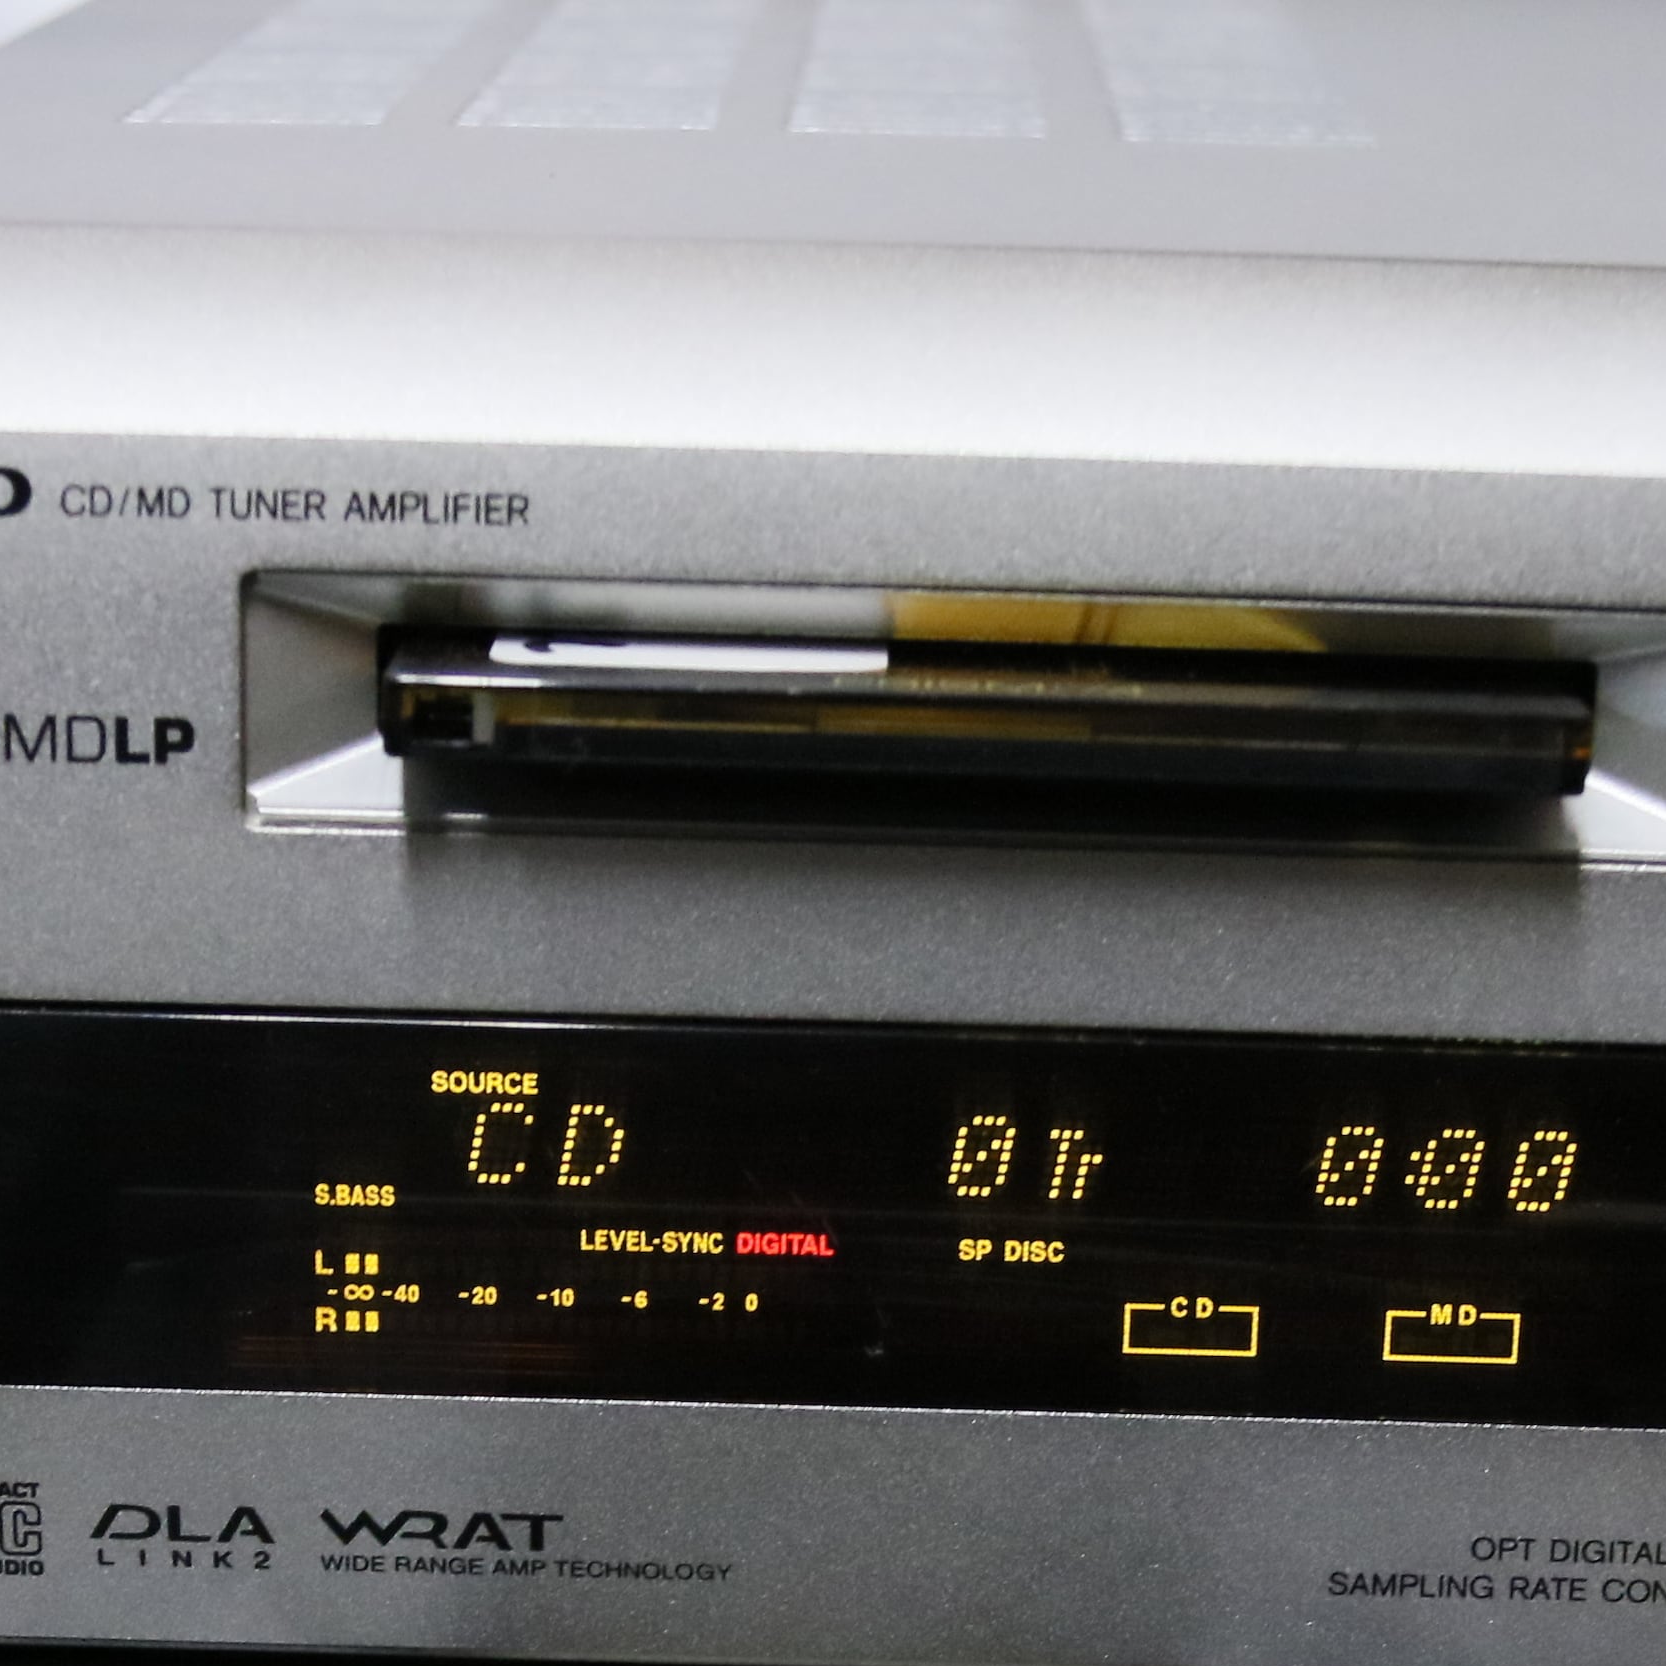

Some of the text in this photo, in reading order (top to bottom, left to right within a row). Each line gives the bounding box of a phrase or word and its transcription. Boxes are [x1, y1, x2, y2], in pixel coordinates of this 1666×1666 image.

[60, 485, 529, 525] CD/MD TUNER AMPLIFIER
[3, 713, 195, 765] MDLP
[430, 1069, 539, 1096] SOURCE
[467, 1102, 625, 1187] CD
[314, 1182, 396, 1207] S.BASS
[580, 1228, 835, 1257] LEVEL-SYNC DIGITAL
[958, 1238, 1065, 1264] SP DISC
[314, 1249, 335, 1276] L
[381, 1283, 420, 1304] -40
[458, 1285, 498, 1306] -20
[536, 1287, 575, 1308] -10
[620, 1290, 648, 1309] -6
[698, 1292, 725, 1311] -2
[744, 1292, 759, 1313] 0
[1170, 1295, 1215, 1319] CD
[315, 1306, 338, 1333] R
[1429, 1303, 1478, 1326] MD
[320, 1509, 564, 1552] WRAT
[1470, 1536, 1536, 1562] OPT
[321, 1555, 731, 1581] WIDE RANGE AMP TECHNOLOGY
[1328, 1571, 1494, 1600] SAMPLING
[1509, 1576, 1587, 1602] RATE
